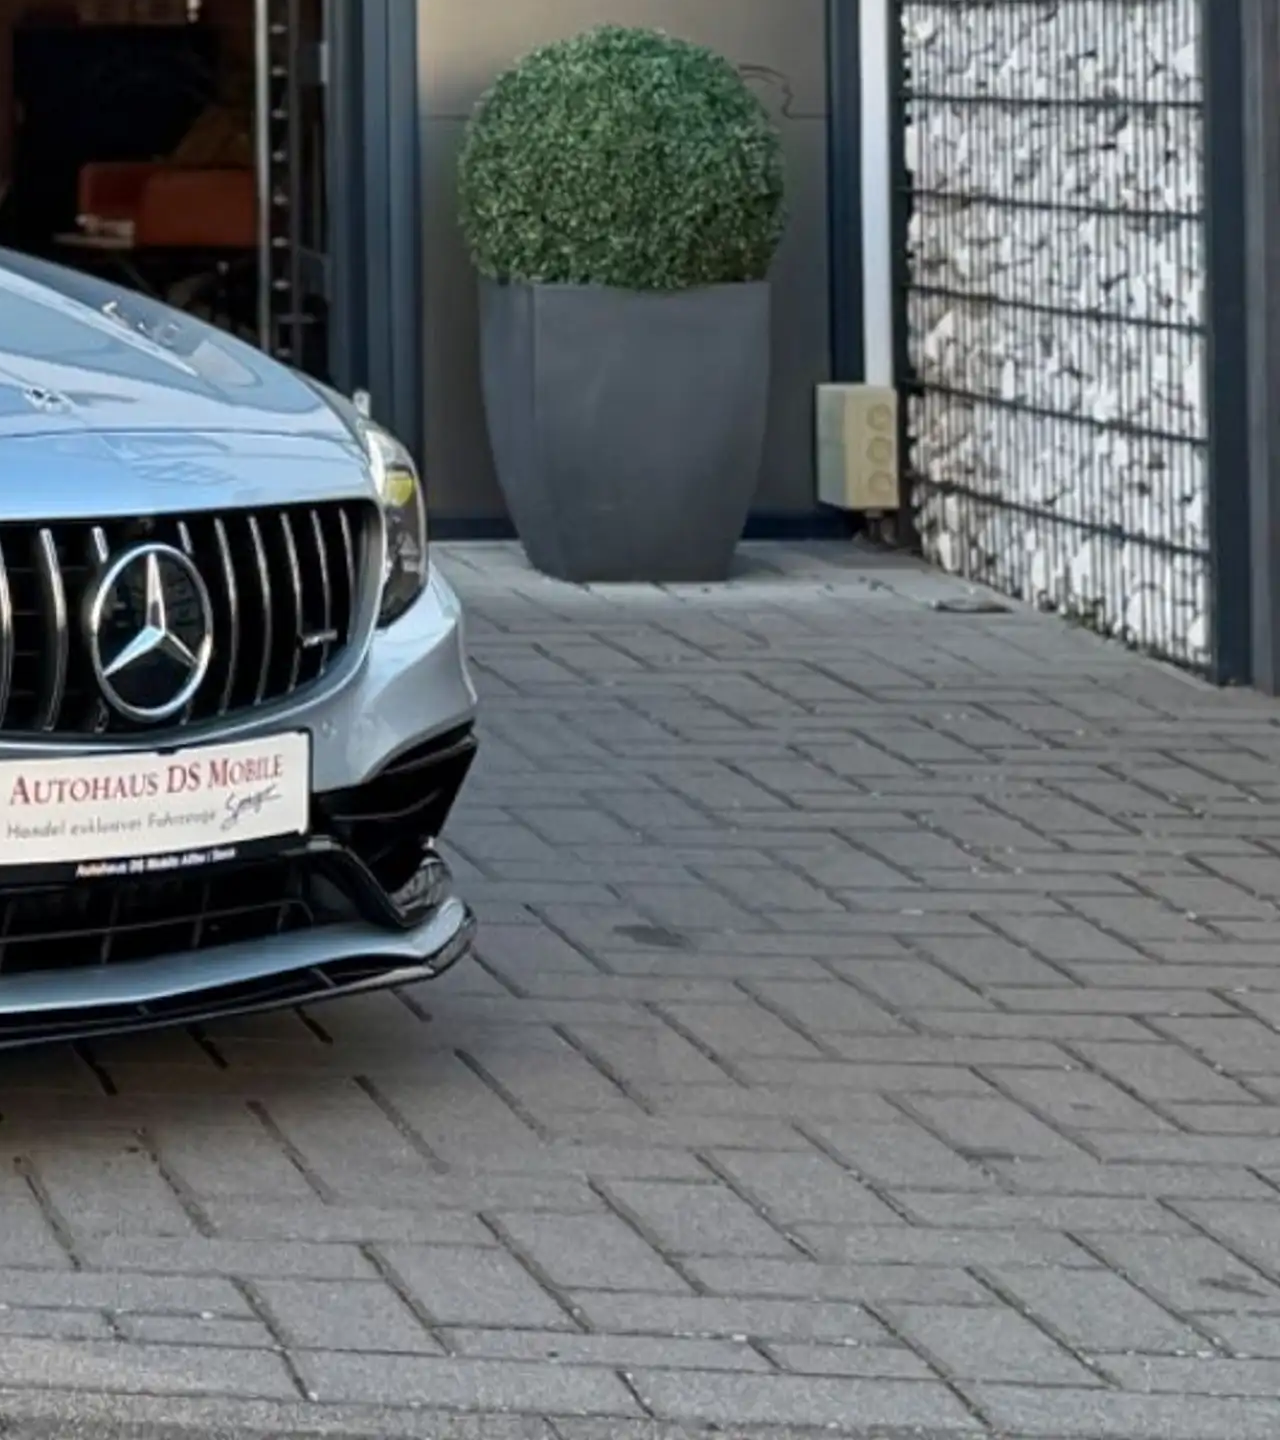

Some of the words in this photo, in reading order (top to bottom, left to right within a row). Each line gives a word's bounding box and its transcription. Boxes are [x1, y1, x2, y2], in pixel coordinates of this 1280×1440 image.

[10, 774, 158, 806] AUTOHAUS
[166, 763, 202, 795] DS
[208, 755, 283, 788] MOBILE
[6, 820, 65, 840] Handel
